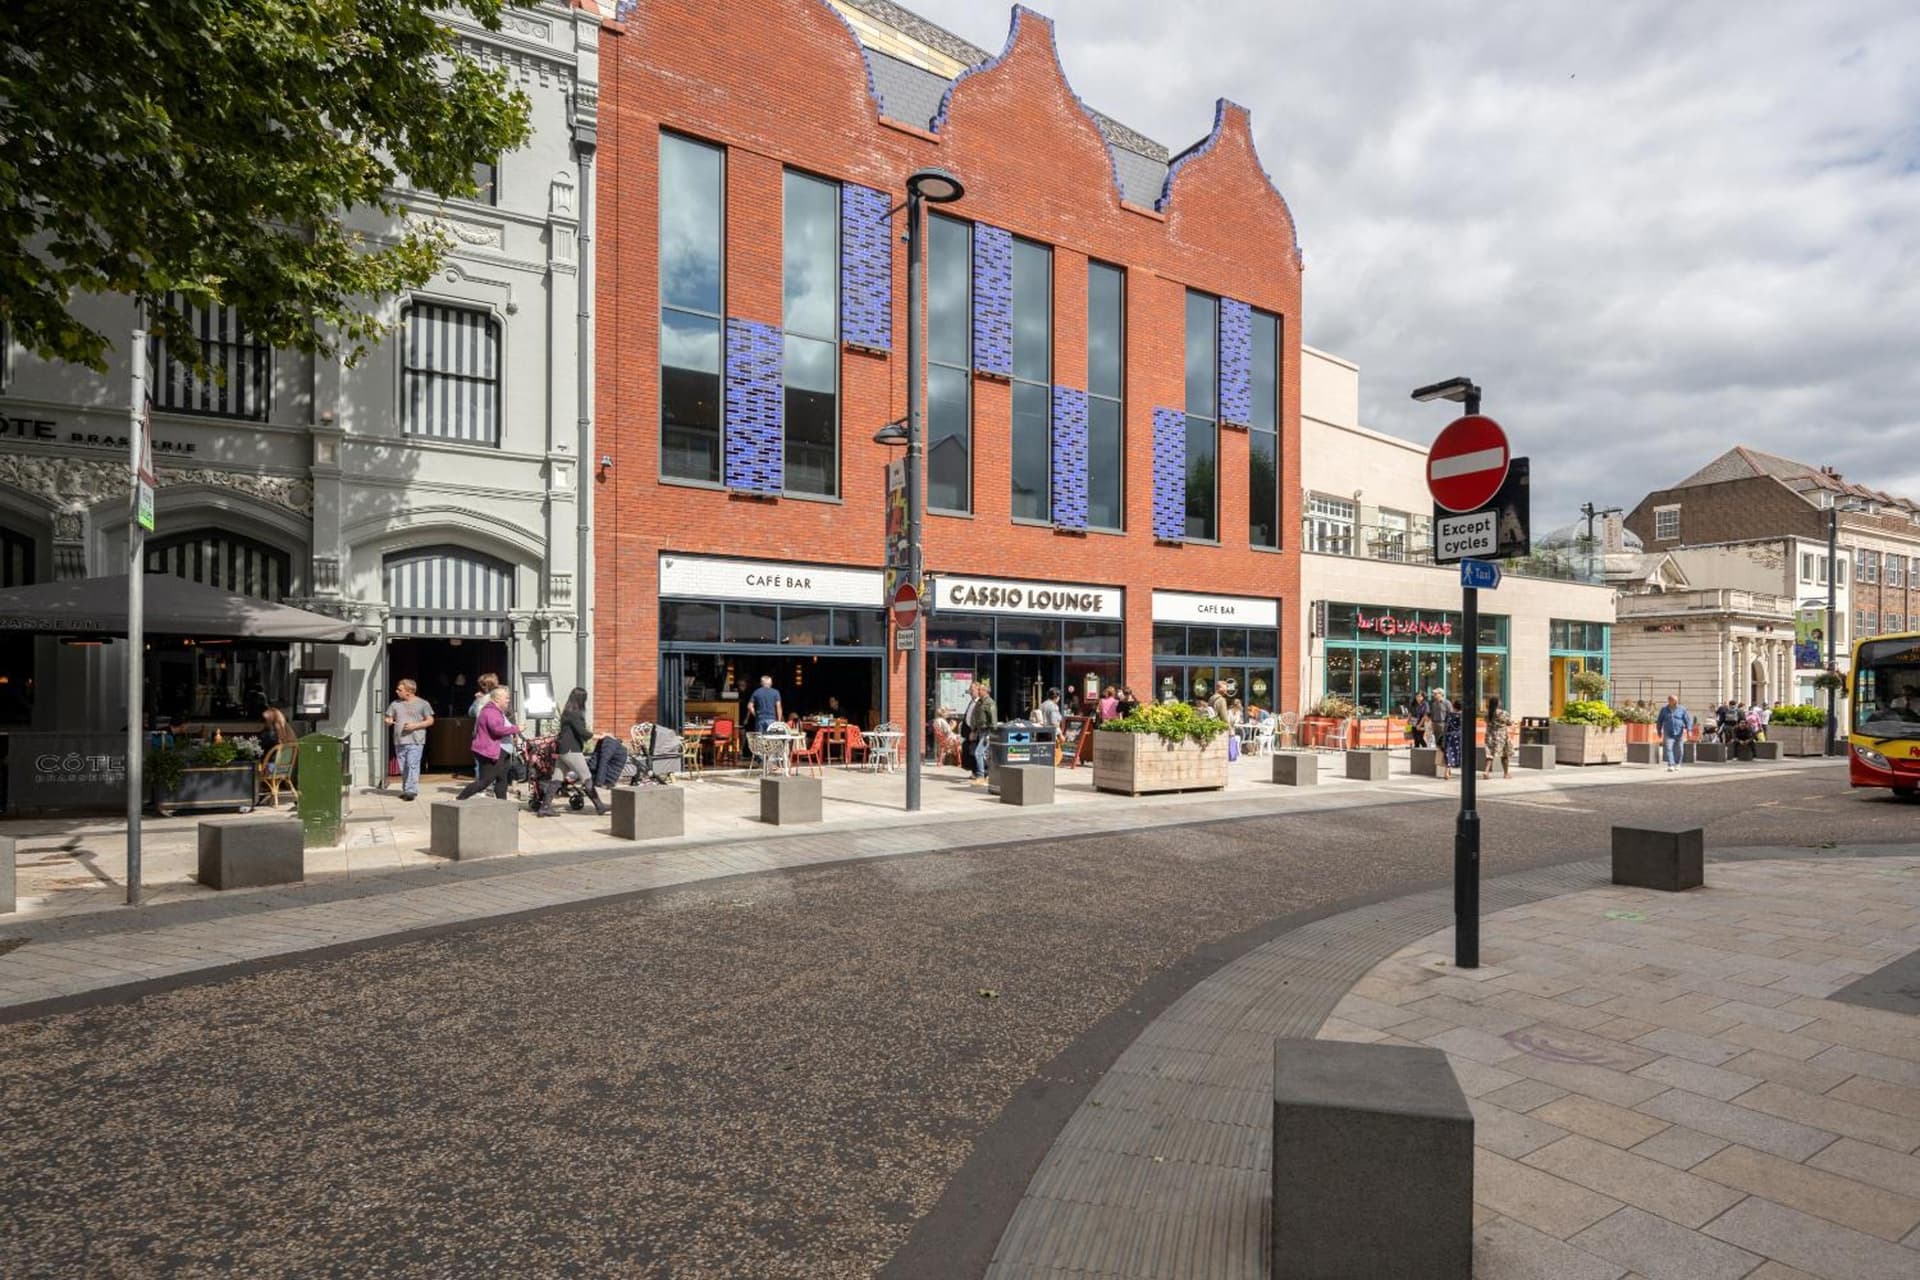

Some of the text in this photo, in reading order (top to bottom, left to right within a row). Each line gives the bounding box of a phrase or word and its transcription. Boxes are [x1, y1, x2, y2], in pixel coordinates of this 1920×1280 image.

[71, 432, 197, 452] BRASERIE
[1442, 518, 1491, 537] Except
[1444, 537, 1489, 554] cycles
[745, 573, 812, 589] CAFÉ BAR
[949, 584, 1023, 609] CASSIO
[1027, 589, 1103, 613] LOUNGE
[1197, 604, 1235, 615] CAFÉ BAR
[1374, 615, 1453, 636] IGUANAS
[35, 752, 126, 773] CÔTE
